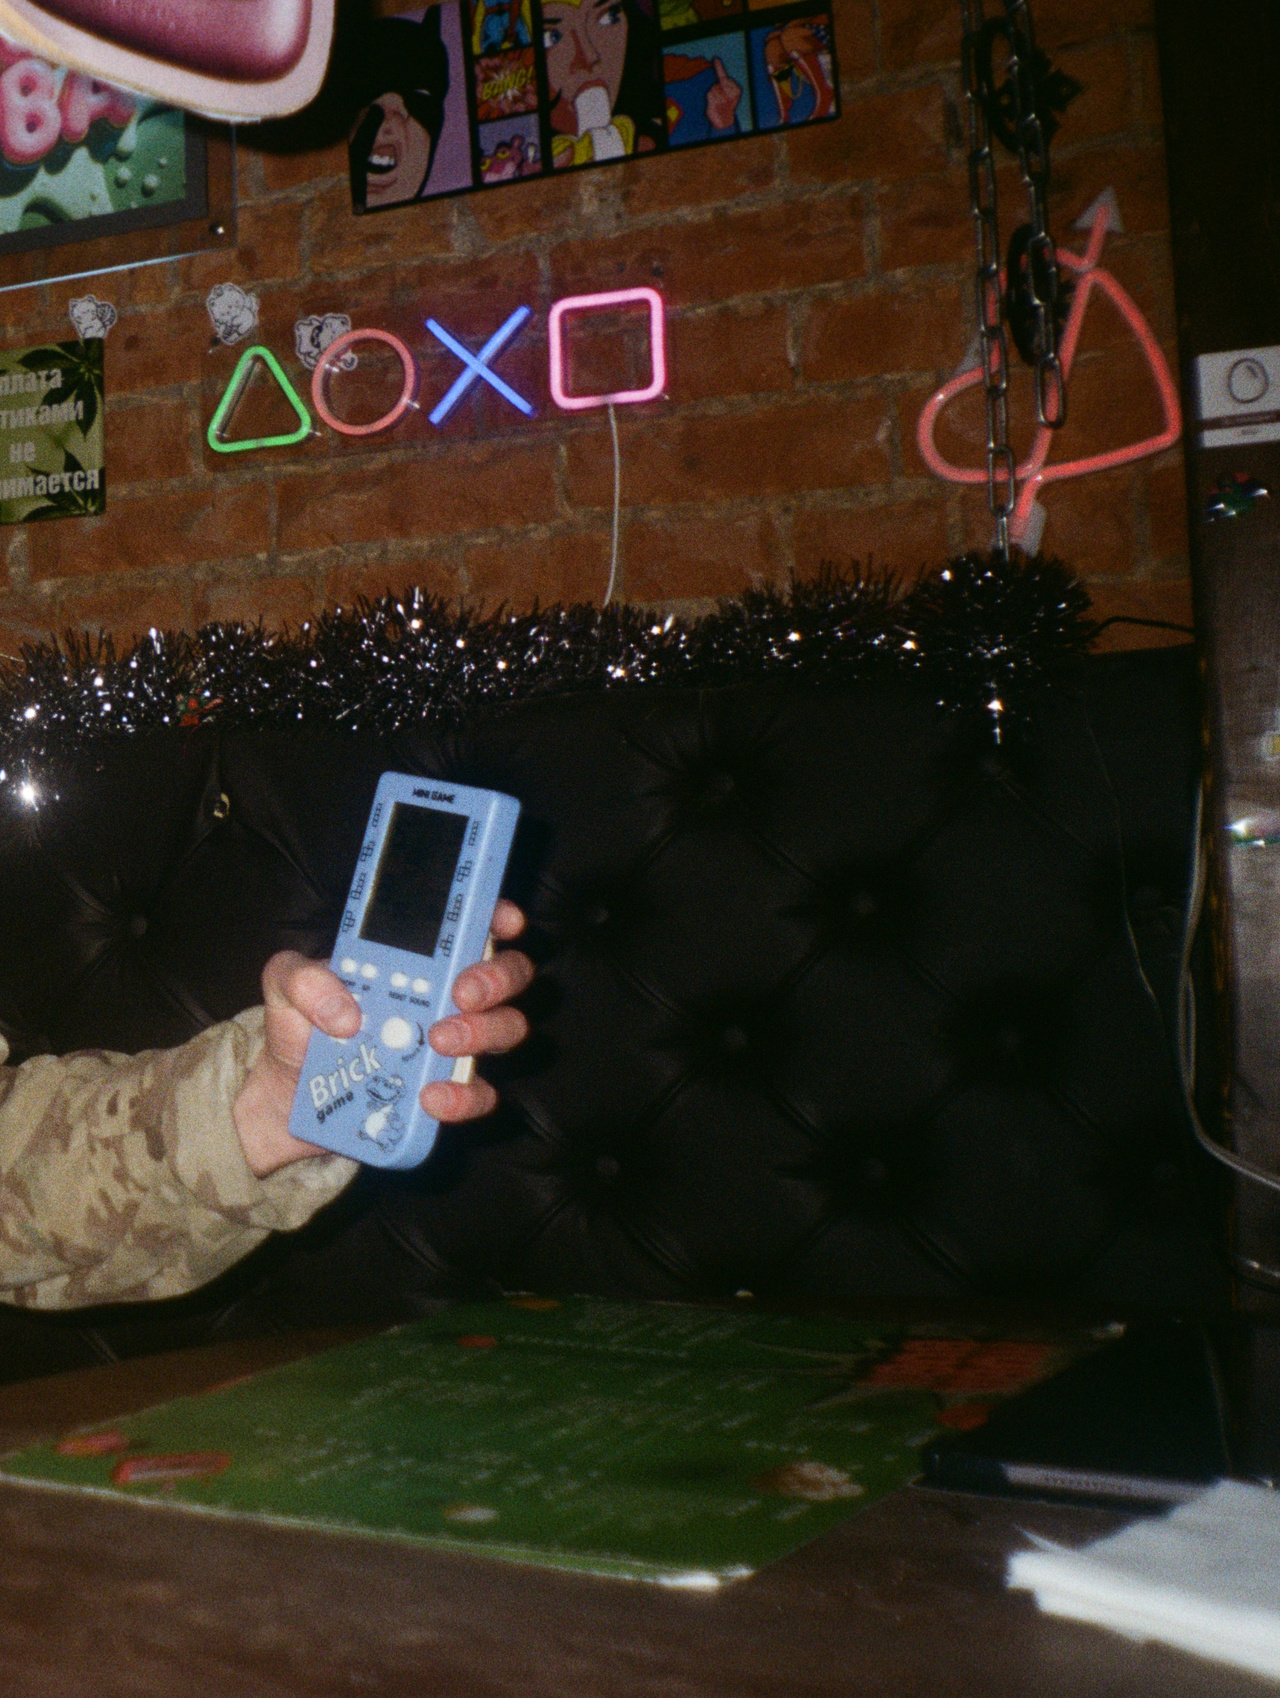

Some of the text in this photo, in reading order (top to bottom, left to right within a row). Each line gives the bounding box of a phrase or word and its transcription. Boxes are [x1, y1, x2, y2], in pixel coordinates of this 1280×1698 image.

[481, 65, 534, 102] BANG!
[9, 441, 36, 464] не
[431, 790, 456, 803] GAME
[307, 1043, 382, 1109] Brick
[316, 1091, 354, 1124] game
